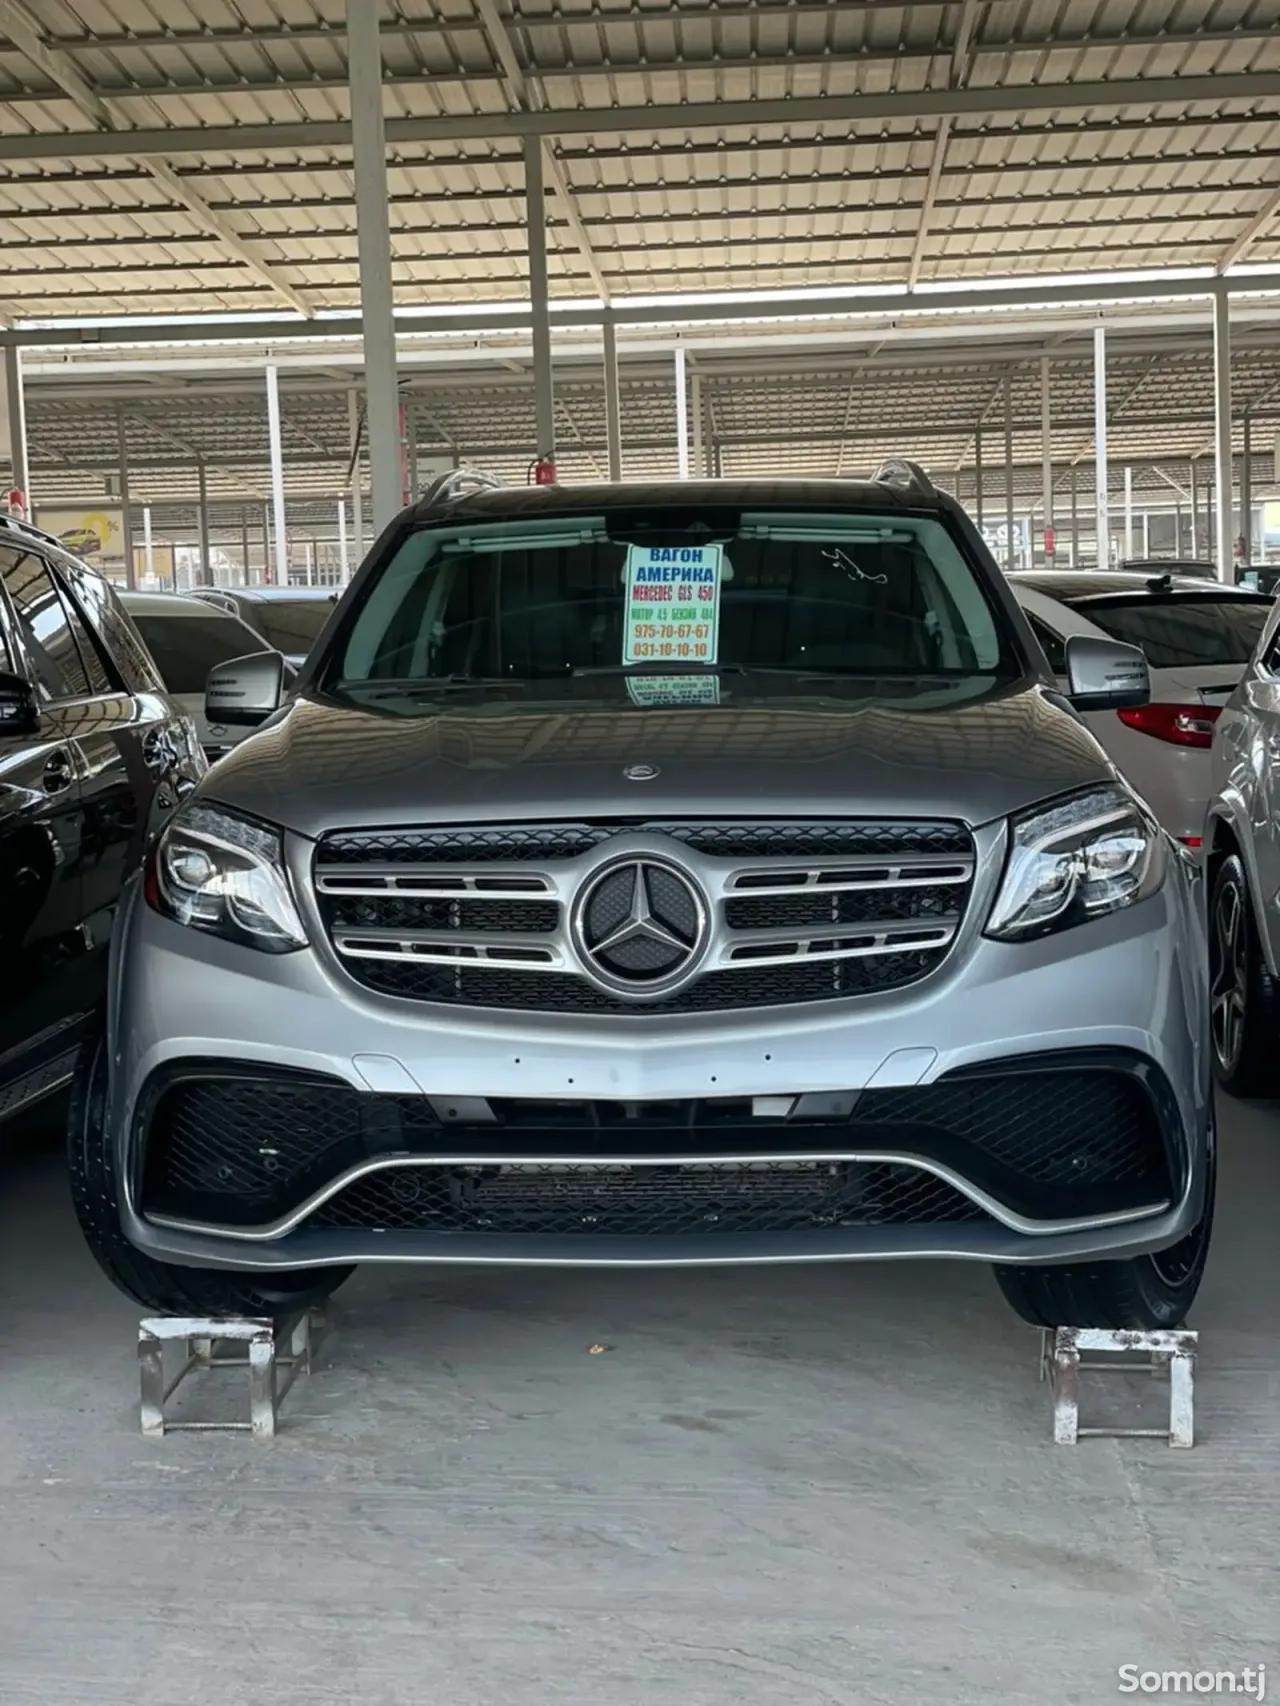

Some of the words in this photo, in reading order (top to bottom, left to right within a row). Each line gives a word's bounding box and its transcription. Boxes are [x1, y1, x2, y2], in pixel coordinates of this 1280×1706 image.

[650, 548, 703, 562] ВАГОН
[636, 567, 713, 581] АМЕРИКА
[698, 585, 713, 601] 450
[635, 624, 708, 638] 975-70-67-67
[634, 643, 707, 656] 031-10-10-10
